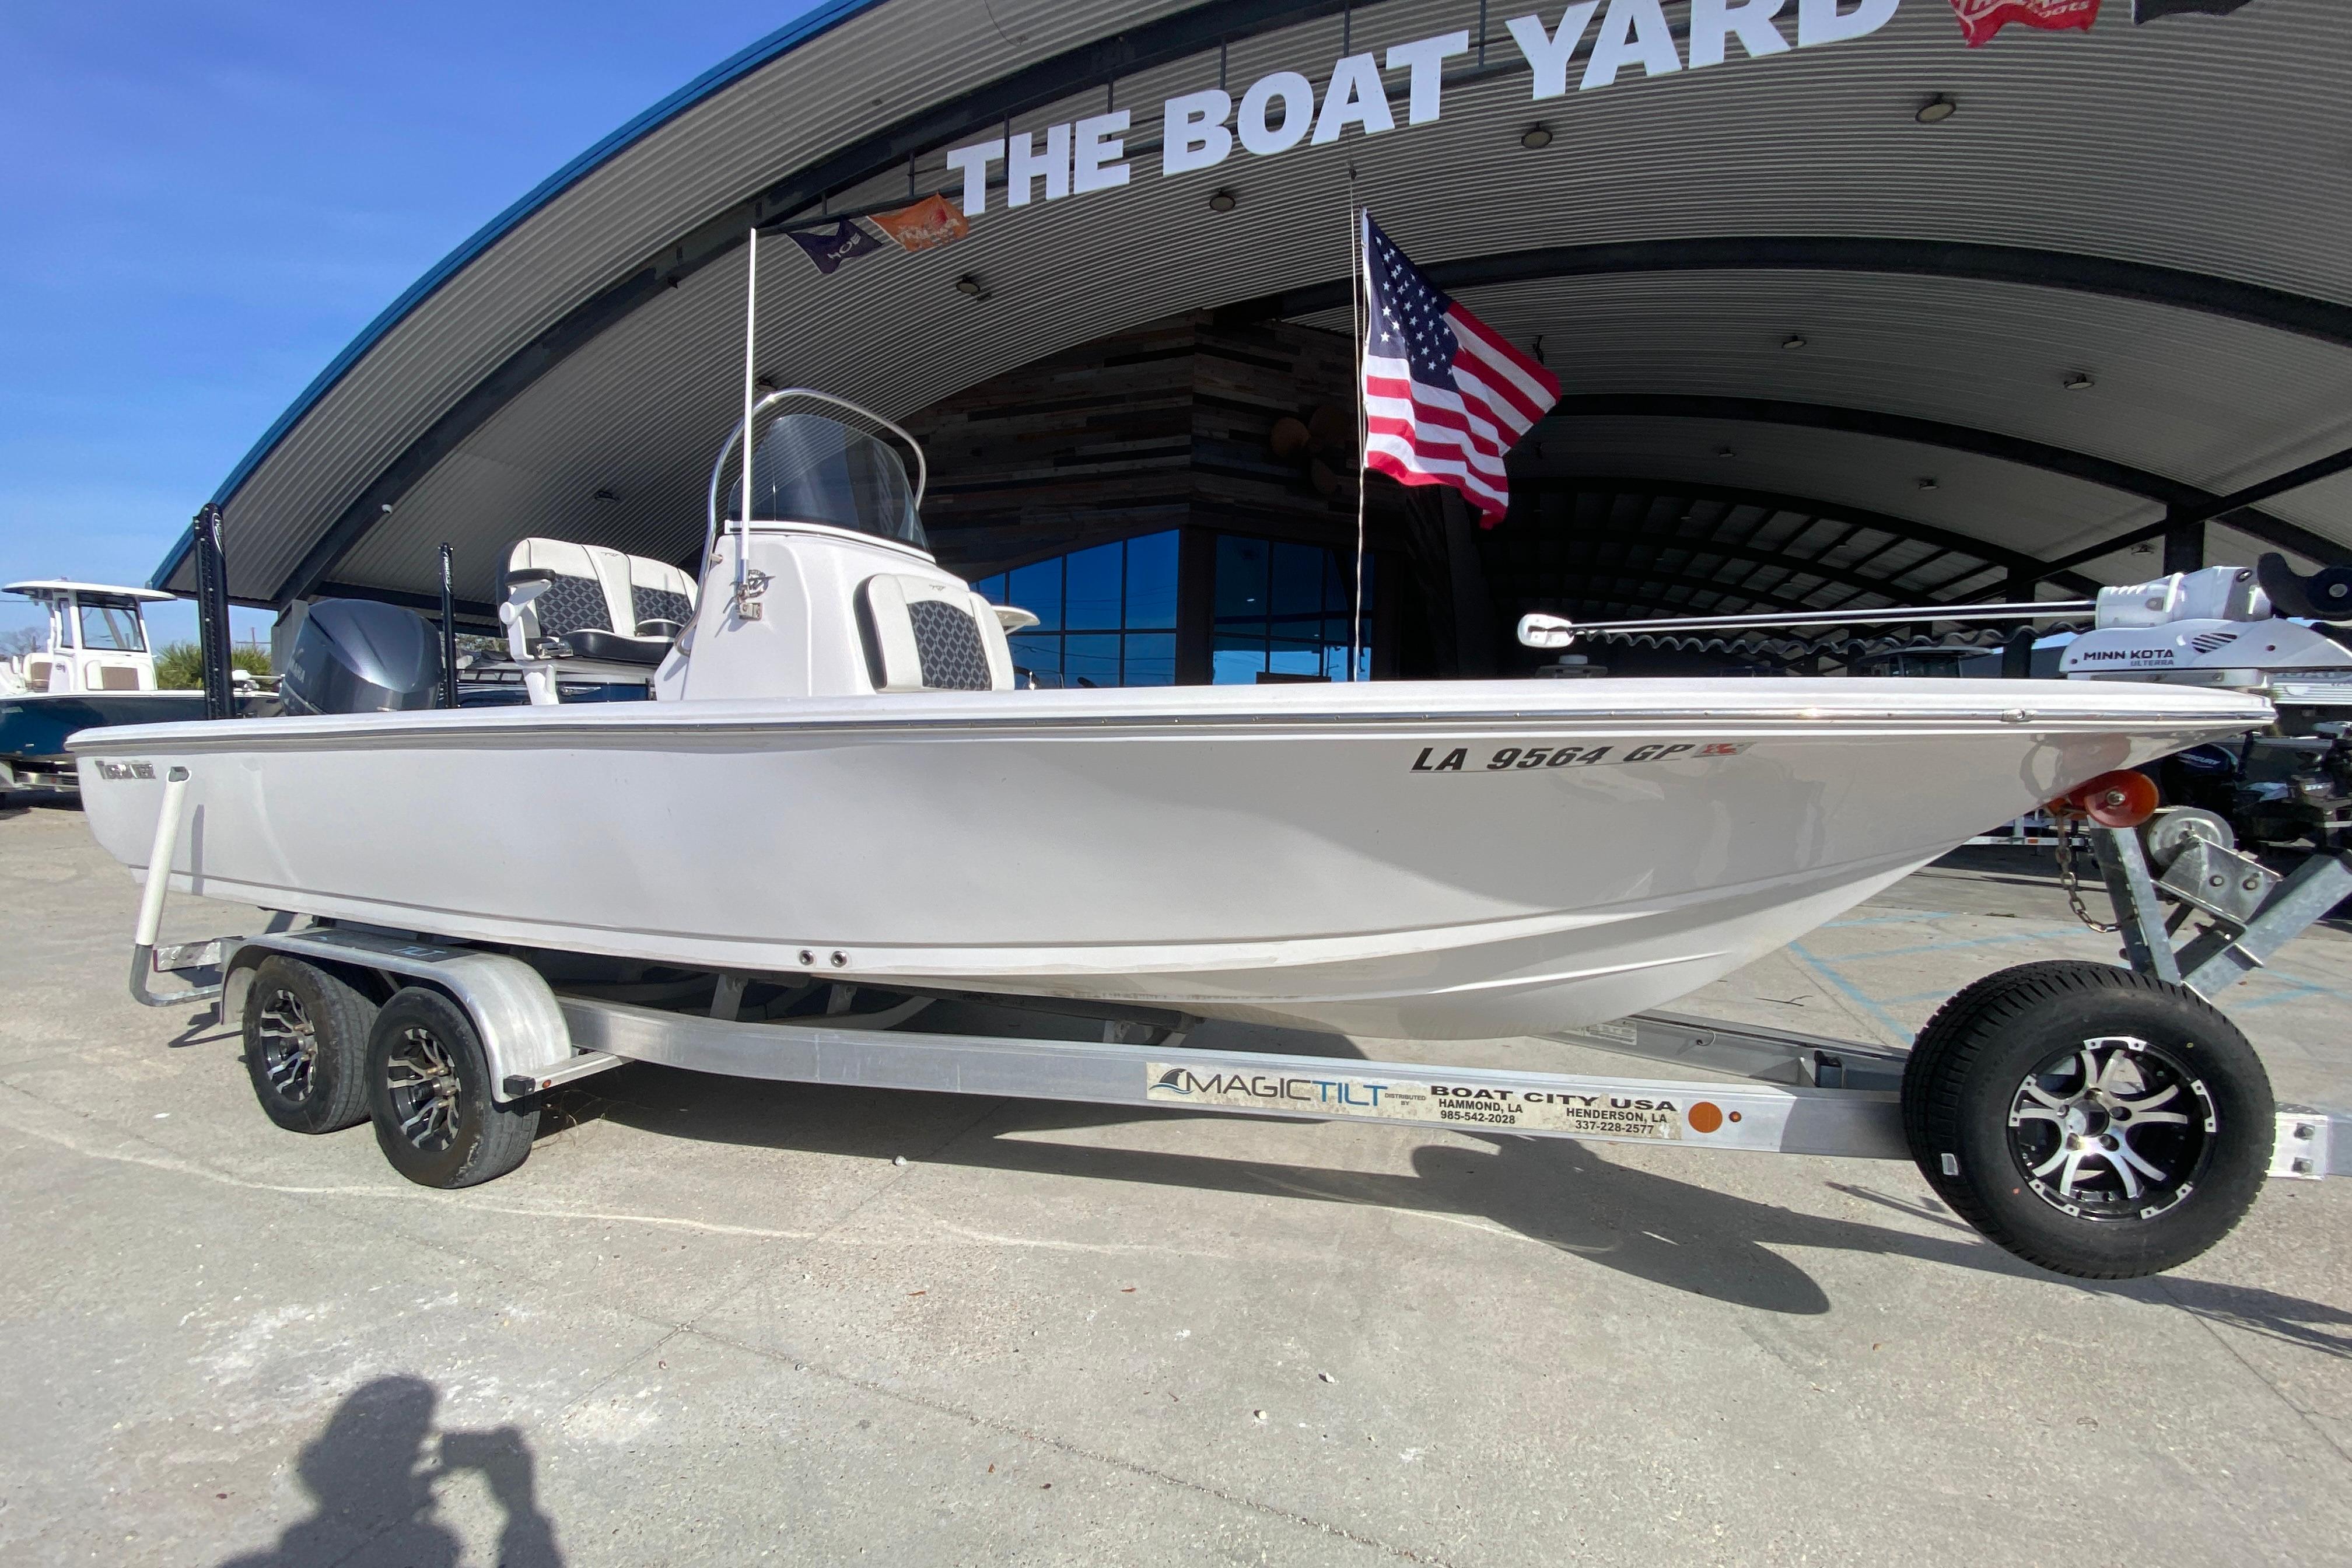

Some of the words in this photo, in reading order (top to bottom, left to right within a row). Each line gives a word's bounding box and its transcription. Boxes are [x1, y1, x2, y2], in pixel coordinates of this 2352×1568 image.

[947, 109, 1130, 217] THE
[1163, 29, 1469, 177] BOAT
[1505, 0, 1899, 100] YARD
[2084, 650, 2126, 660] MINN
[2130, 649, 2174, 659] KOTA
[1411, 747, 1468, 771] LA
[1486, 746, 1614, 770] 9564
[1623, 744, 1696, 762] GP
[1384, 1093, 1426, 1101] DISTRIBUTED
[1431, 1085, 1513, 1100] BOAT
[1524, 1092, 1599, 1107] CITY
[1611, 1098, 1677, 1111] USA
[1439, 1098, 1504, 1114] HAMMOND,
[1508, 1103, 1523, 1113] LA
[1441, 1110, 1516, 1124] 985-542-2028
[1566, 1107, 1647, 1124] HENDERSON,
[1652, 1113, 1667, 1123] LA
[1575, 1120, 1654, 1134] 337-228-2577
